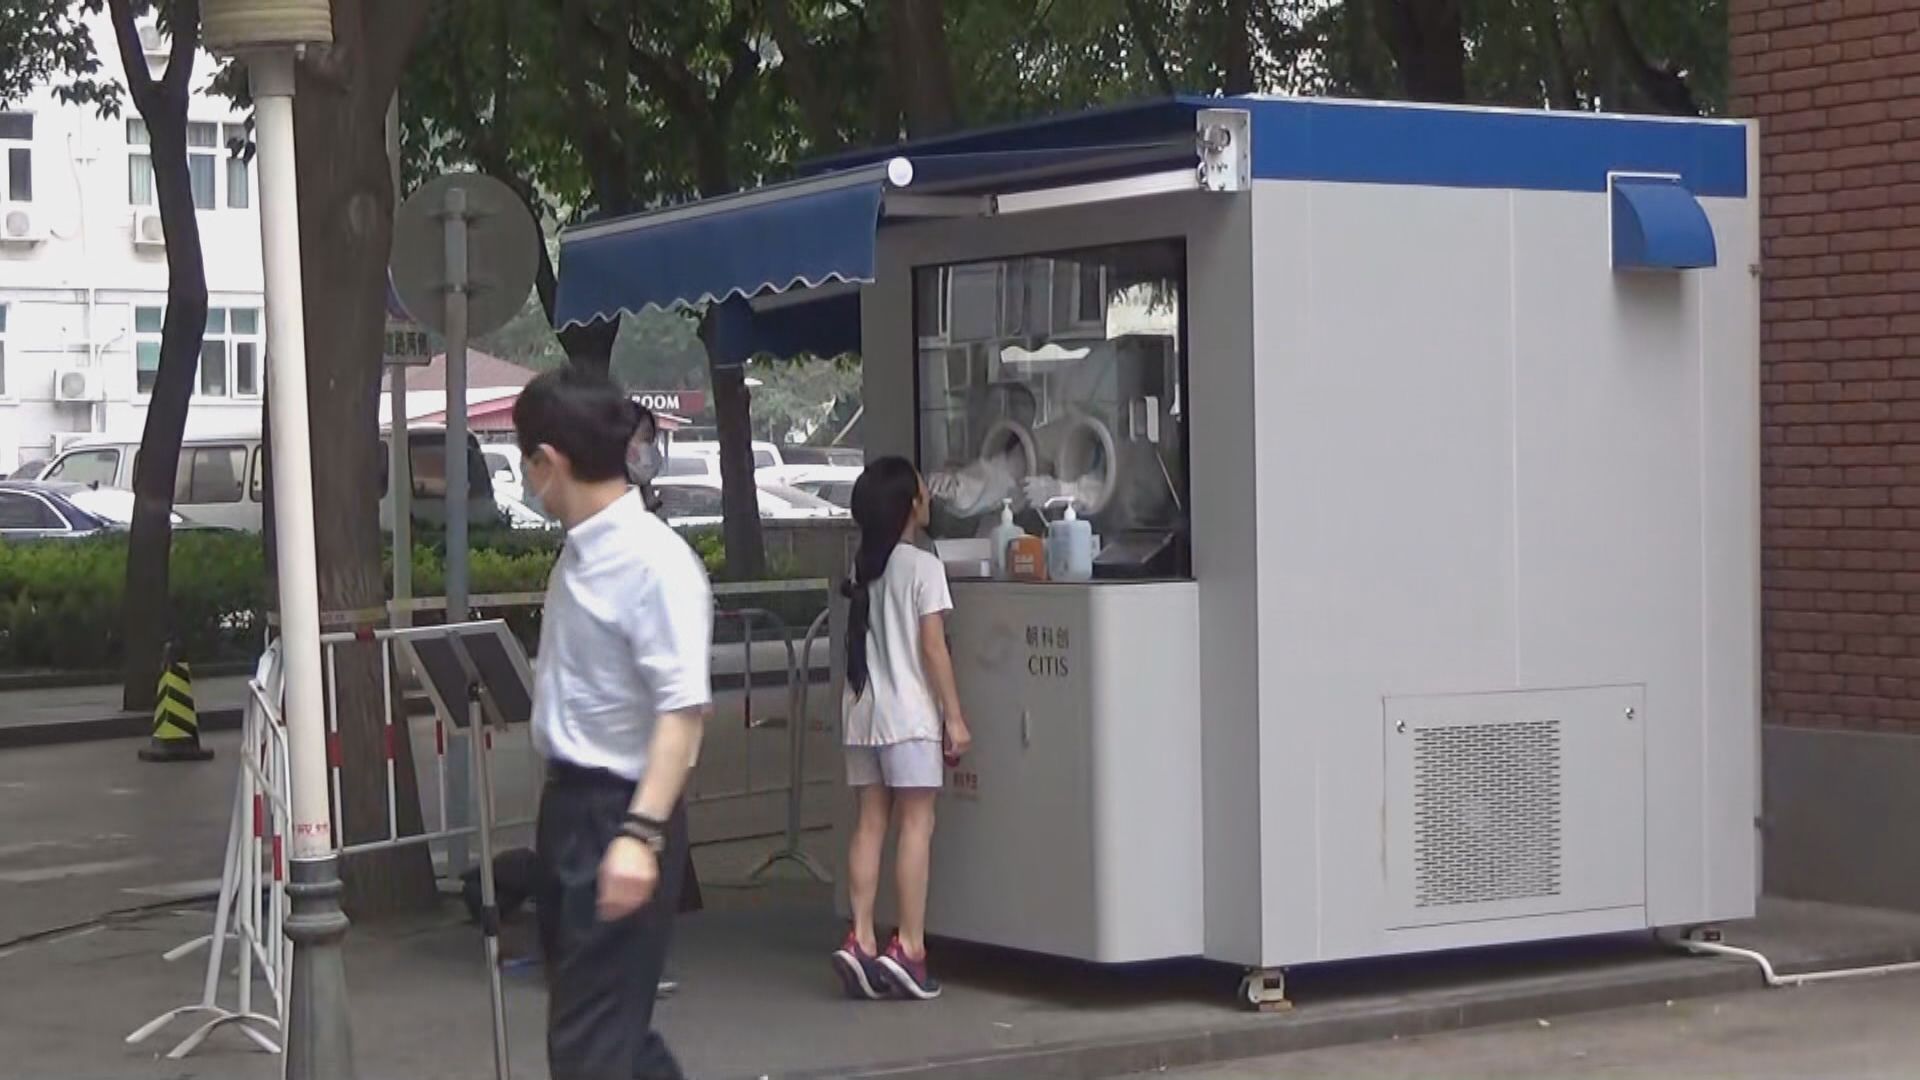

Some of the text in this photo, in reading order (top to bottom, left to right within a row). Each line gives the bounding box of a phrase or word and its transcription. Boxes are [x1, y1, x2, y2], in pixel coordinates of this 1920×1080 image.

[1026, 625, 1069, 649] 朝科创
[1028, 655, 1069, 677] CITIS
